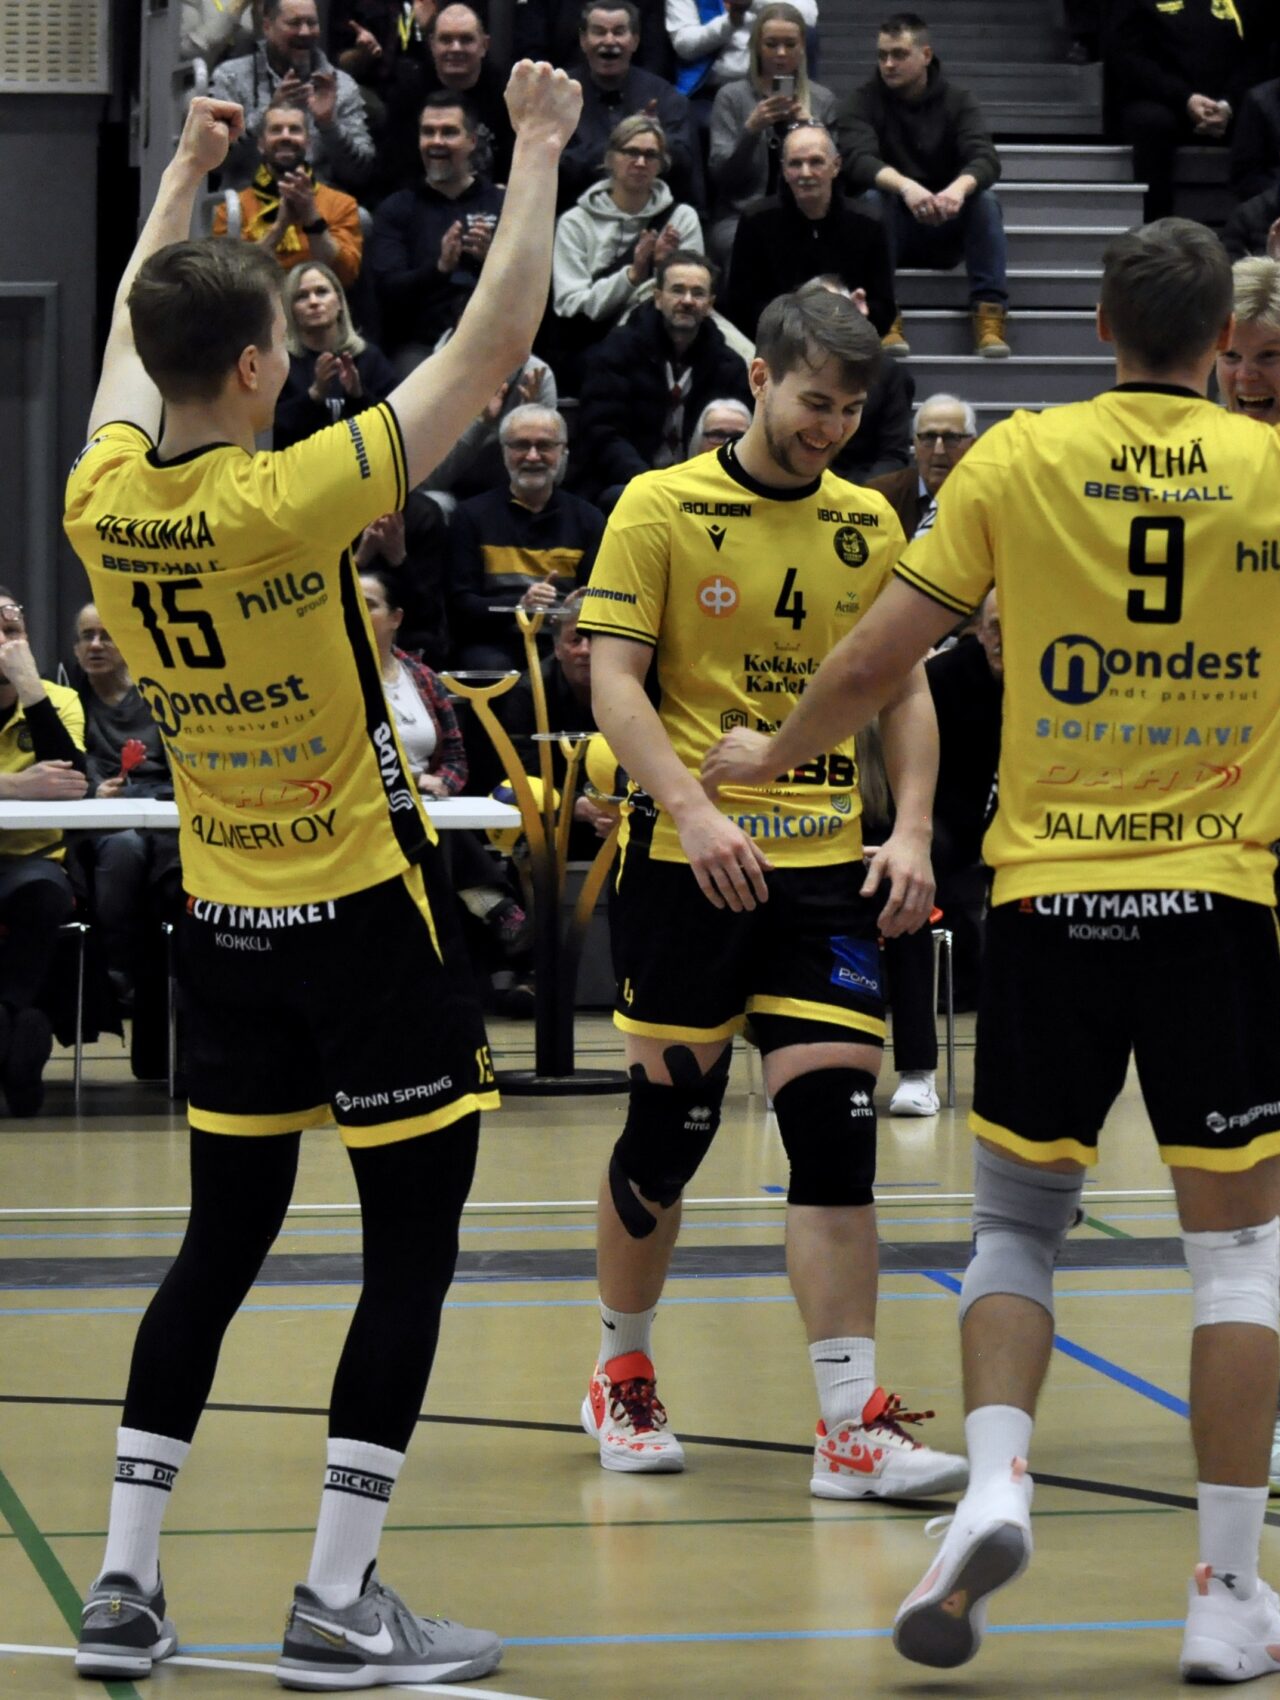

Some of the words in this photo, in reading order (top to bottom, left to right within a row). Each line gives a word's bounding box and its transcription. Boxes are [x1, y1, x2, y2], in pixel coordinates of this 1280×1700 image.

[1110, 437, 1208, 479] JYLHÄ
[1084, 481, 1233, 503] BEST-HALL
[682, 502, 752, 517] BOLIDEN
[820, 508, 879, 527] BOLIDEN
[1127, 515, 1185, 625] 9
[236, 571, 325, 619] hilla
[774, 567, 807, 630] 4
[132, 577, 225, 669] 15
[191, 814, 285, 850] ALMERI
[290, 808, 337, 844] OY
[728, 805, 843, 838] micore
[1034, 812, 1184, 841] JALMERI
[1196, 812, 1244, 840] OY
[1035, 889, 1214, 919] CITYMARKET
[352, 1092, 389, 1109] FINN
[392, 1075, 453, 1103] SPRING
[329, 1470, 393, 1496] DICKIES
